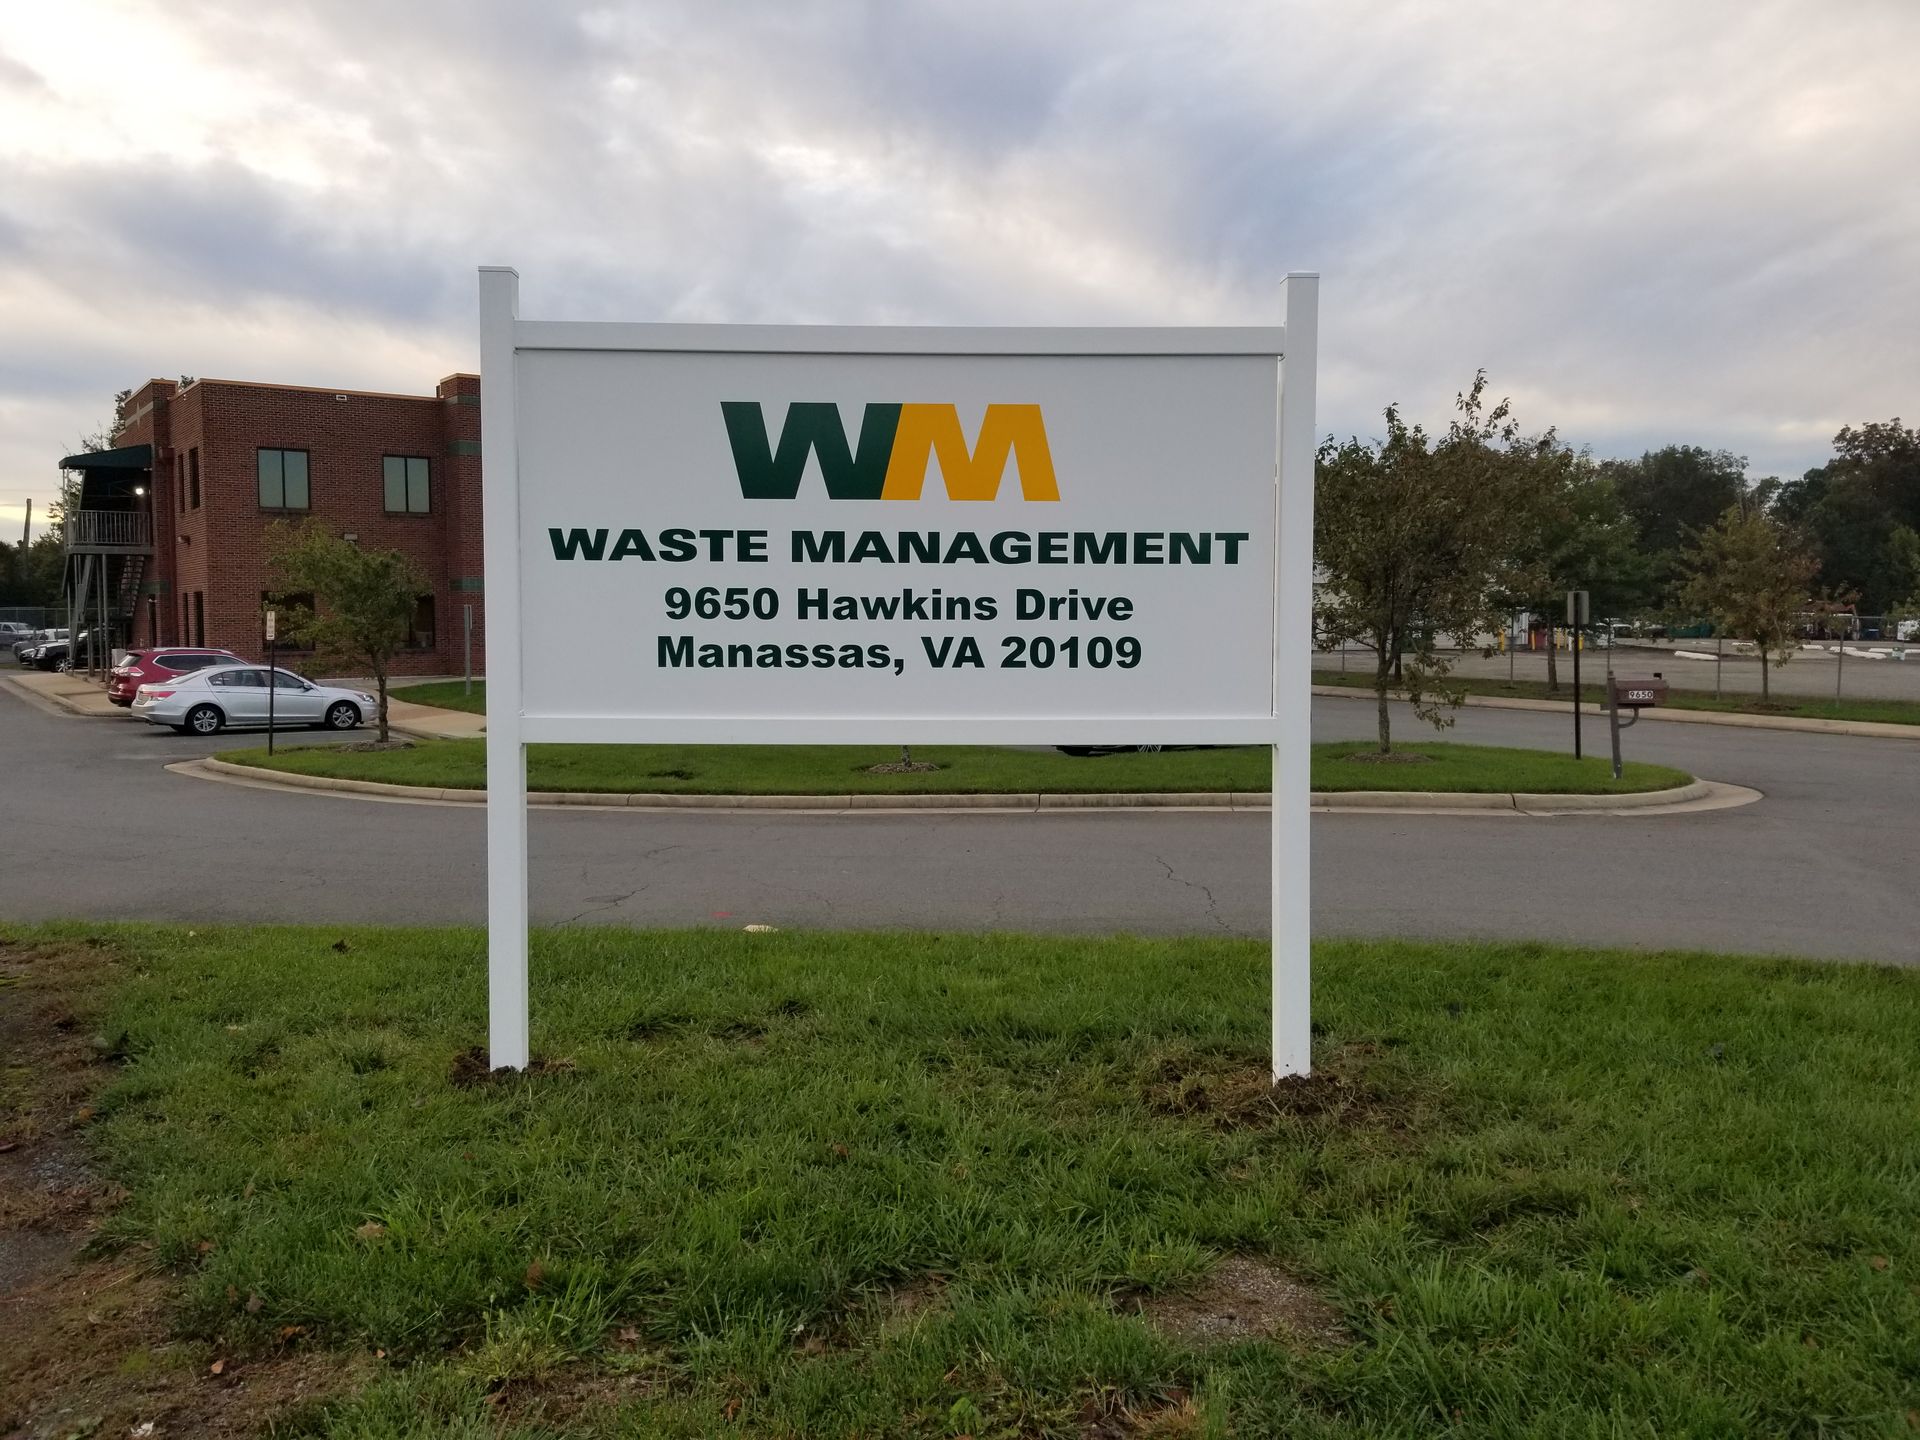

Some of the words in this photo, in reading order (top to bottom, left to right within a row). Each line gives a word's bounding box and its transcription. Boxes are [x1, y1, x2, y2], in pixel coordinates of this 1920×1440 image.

[720, 401, 1060, 501] WM
[548, 528, 768, 562] WASTE
[792, 530, 1249, 564] MANAGEMENT
[665, 587, 779, 620] 9650
[798, 588, 997, 620] Hawkins
[1017, 589, 1133, 621] Drive
[658, 636, 904, 676] Manassas,
[921, 637, 985, 668] VA
[1001, 636, 1141, 668] 20109
[1629, 691, 1653, 699] 9650
